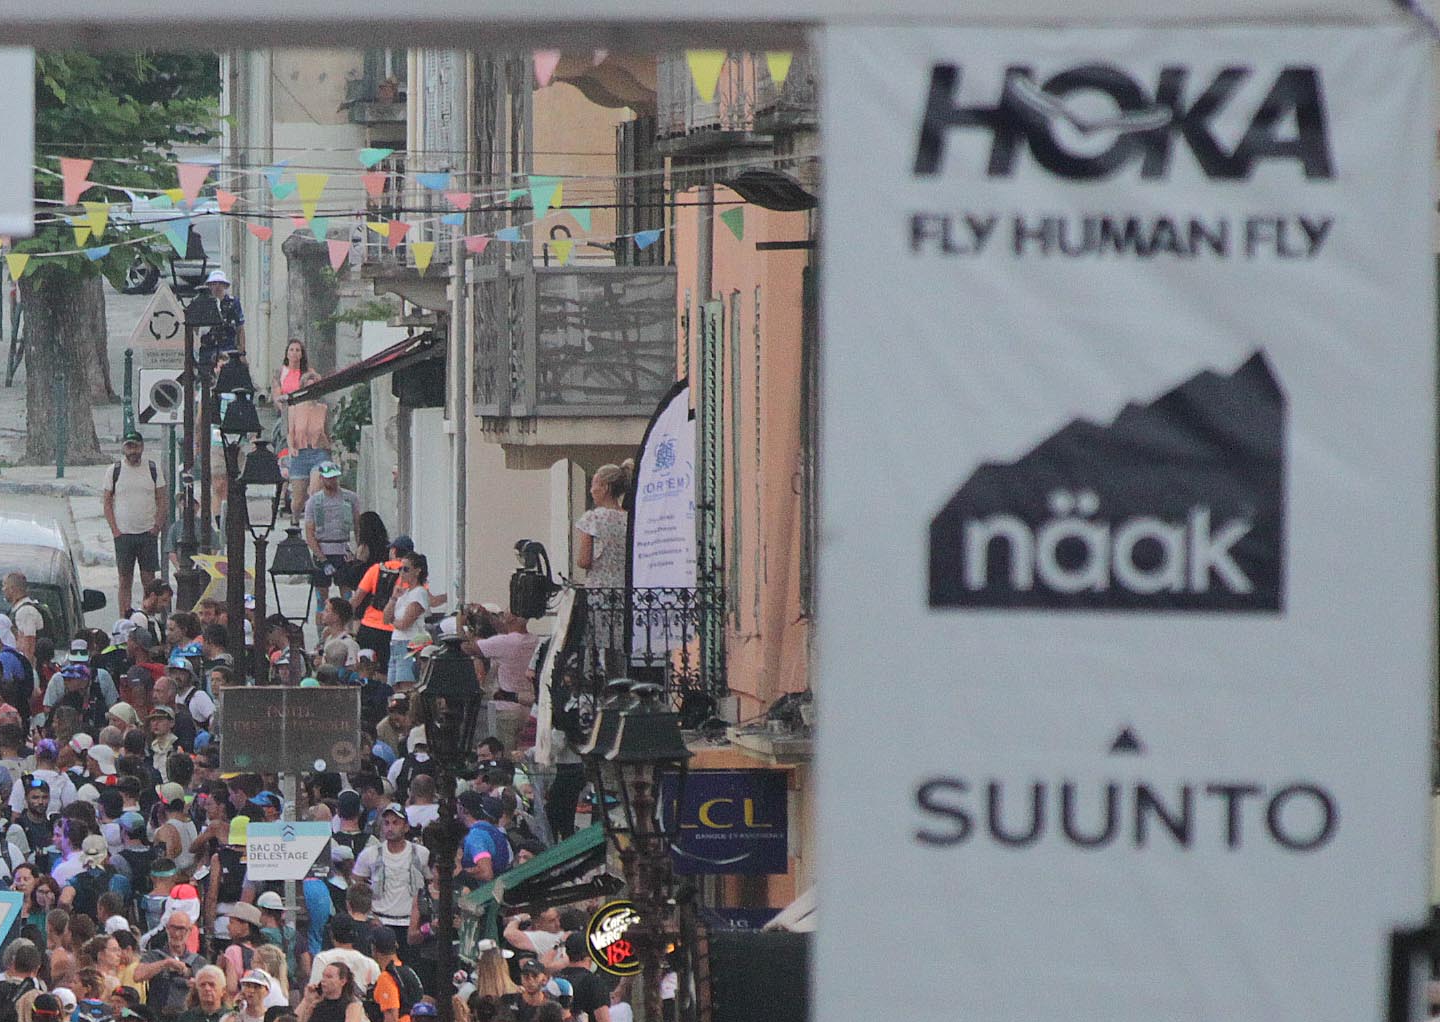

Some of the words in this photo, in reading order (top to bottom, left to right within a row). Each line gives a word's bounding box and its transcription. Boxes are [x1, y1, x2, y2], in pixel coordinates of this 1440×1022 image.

[911, 62, 1337, 183] HOKA
[908, 213, 1000, 258] FLY
[1013, 213, 1229, 258] HUMAN
[1245, 214, 1335, 259] FLY
[965, 488, 1257, 595] näak
[913, 777, 1339, 851] SUUNTO
[249, 843, 270, 852] SAC
[273, 843, 286, 852] DE
[249, 851, 309, 861] DELESTAGE
